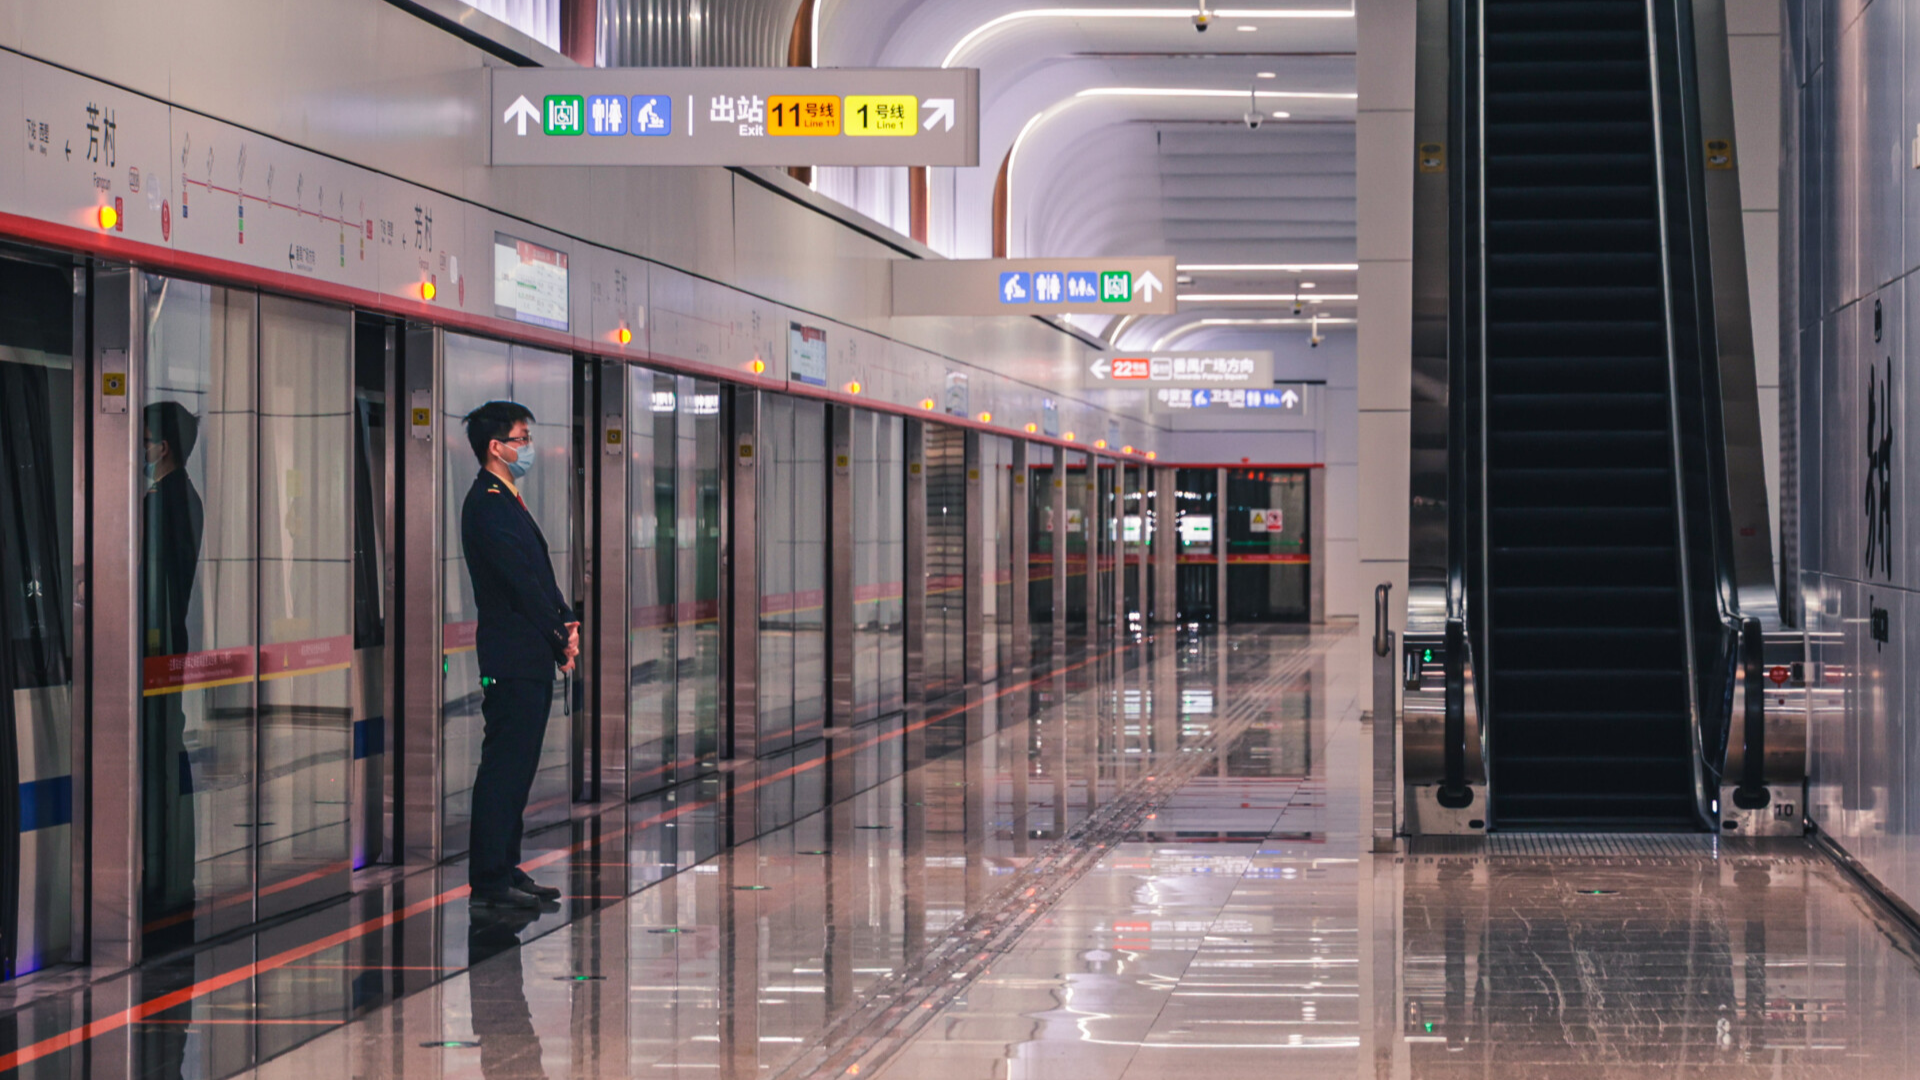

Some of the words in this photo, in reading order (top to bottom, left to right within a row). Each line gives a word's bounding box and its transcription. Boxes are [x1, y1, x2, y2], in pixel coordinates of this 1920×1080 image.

[710, 95, 764, 124] 出站
[772, 102, 800, 128] 11
[805, 102, 835, 118] 号线
[857, 103, 868, 129] 1
[875, 104, 905, 120] 号线
[739, 124, 764, 137] Exit
[804, 119, 824, 129] Line
[825, 119, 835, 128] 11
[876, 121, 895, 130] Line
[86, 101, 117, 168] 芳村
[92, 171, 112, 192] Fangcun
[1113, 361, 1132, 378] 22
[1173, 357, 1254, 375] 番禺广场方向
[1774, 803, 1794, 818] 10
